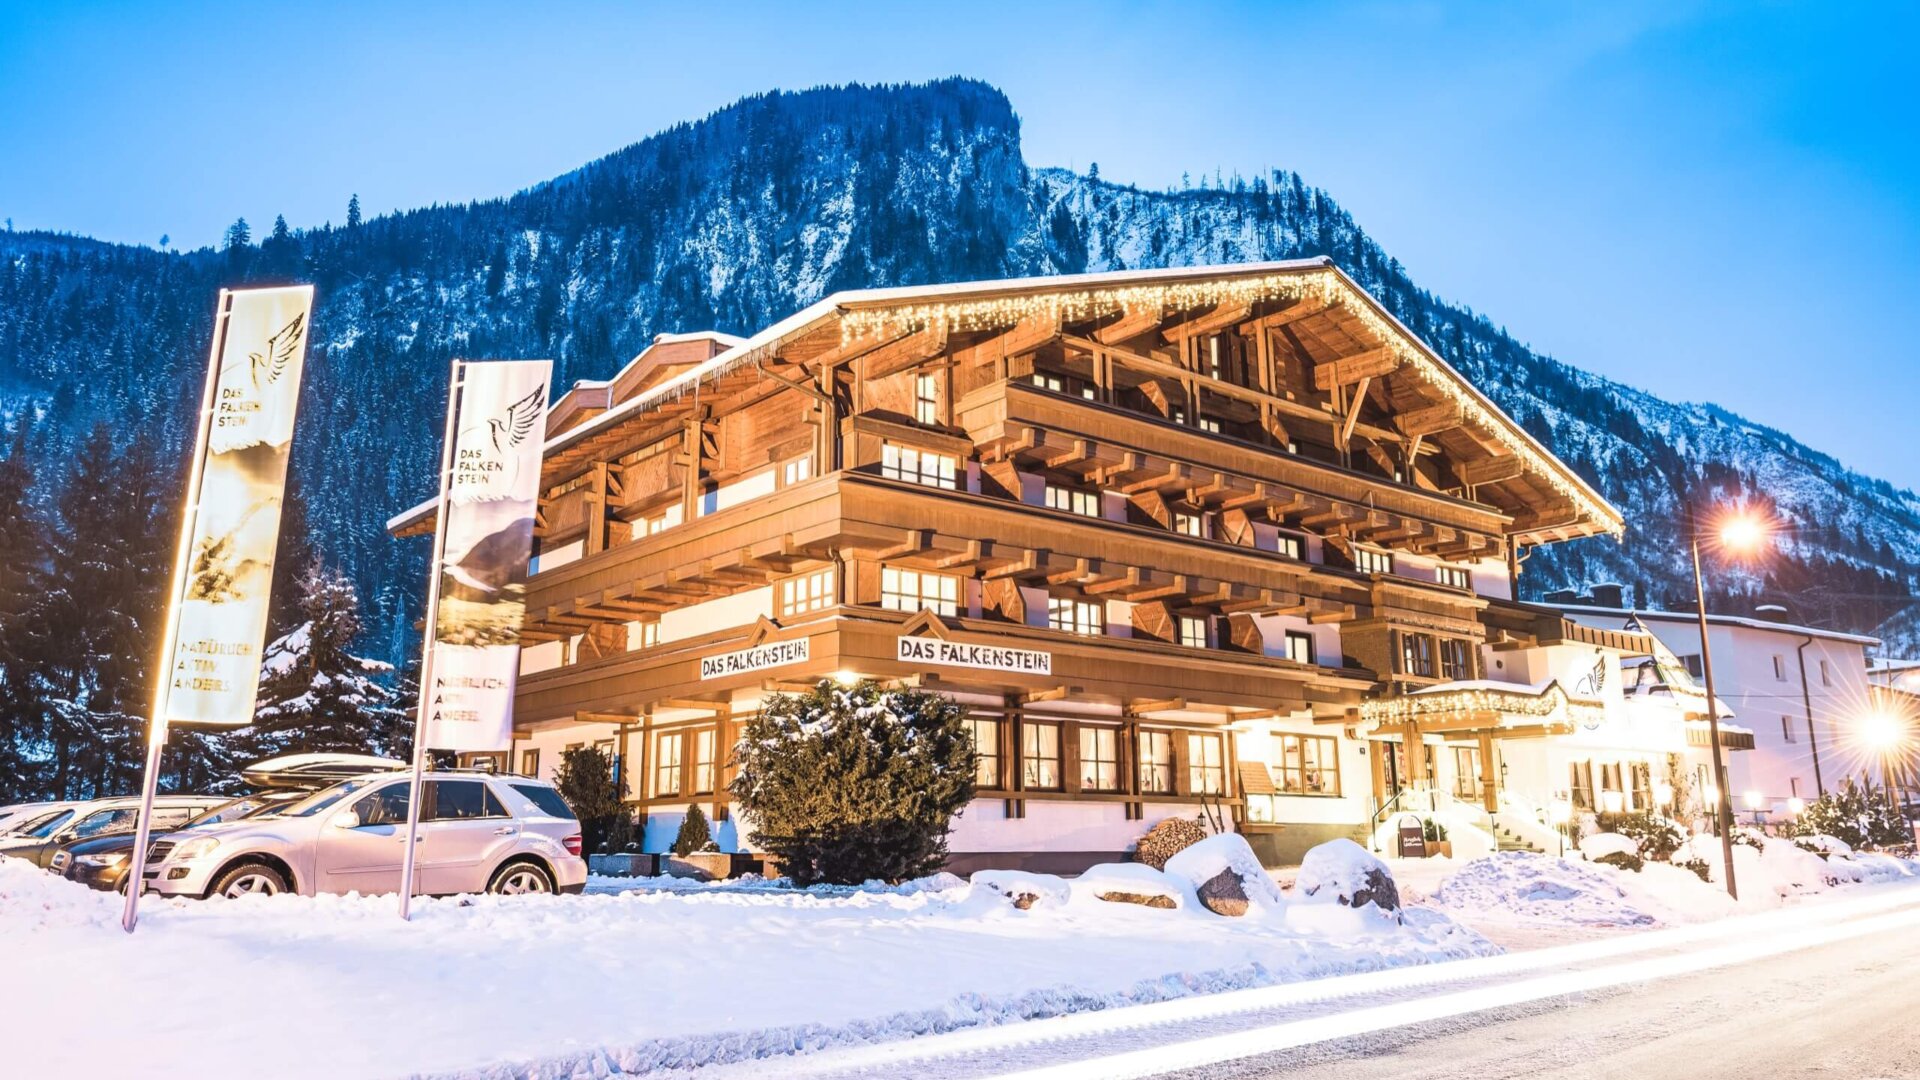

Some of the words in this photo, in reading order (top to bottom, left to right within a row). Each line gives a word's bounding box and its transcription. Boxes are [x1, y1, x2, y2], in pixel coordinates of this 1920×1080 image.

[460, 449, 482, 459] DAS
[459, 461, 503, 472] FALKEN
[457, 474, 489, 485] STEIN
[702, 658, 724, 677] DAS
[726, 640, 807, 673] FALKENSTEIN
[900, 639, 935, 660] DAS
[940, 643, 1049, 671] FALKENSTEIN
